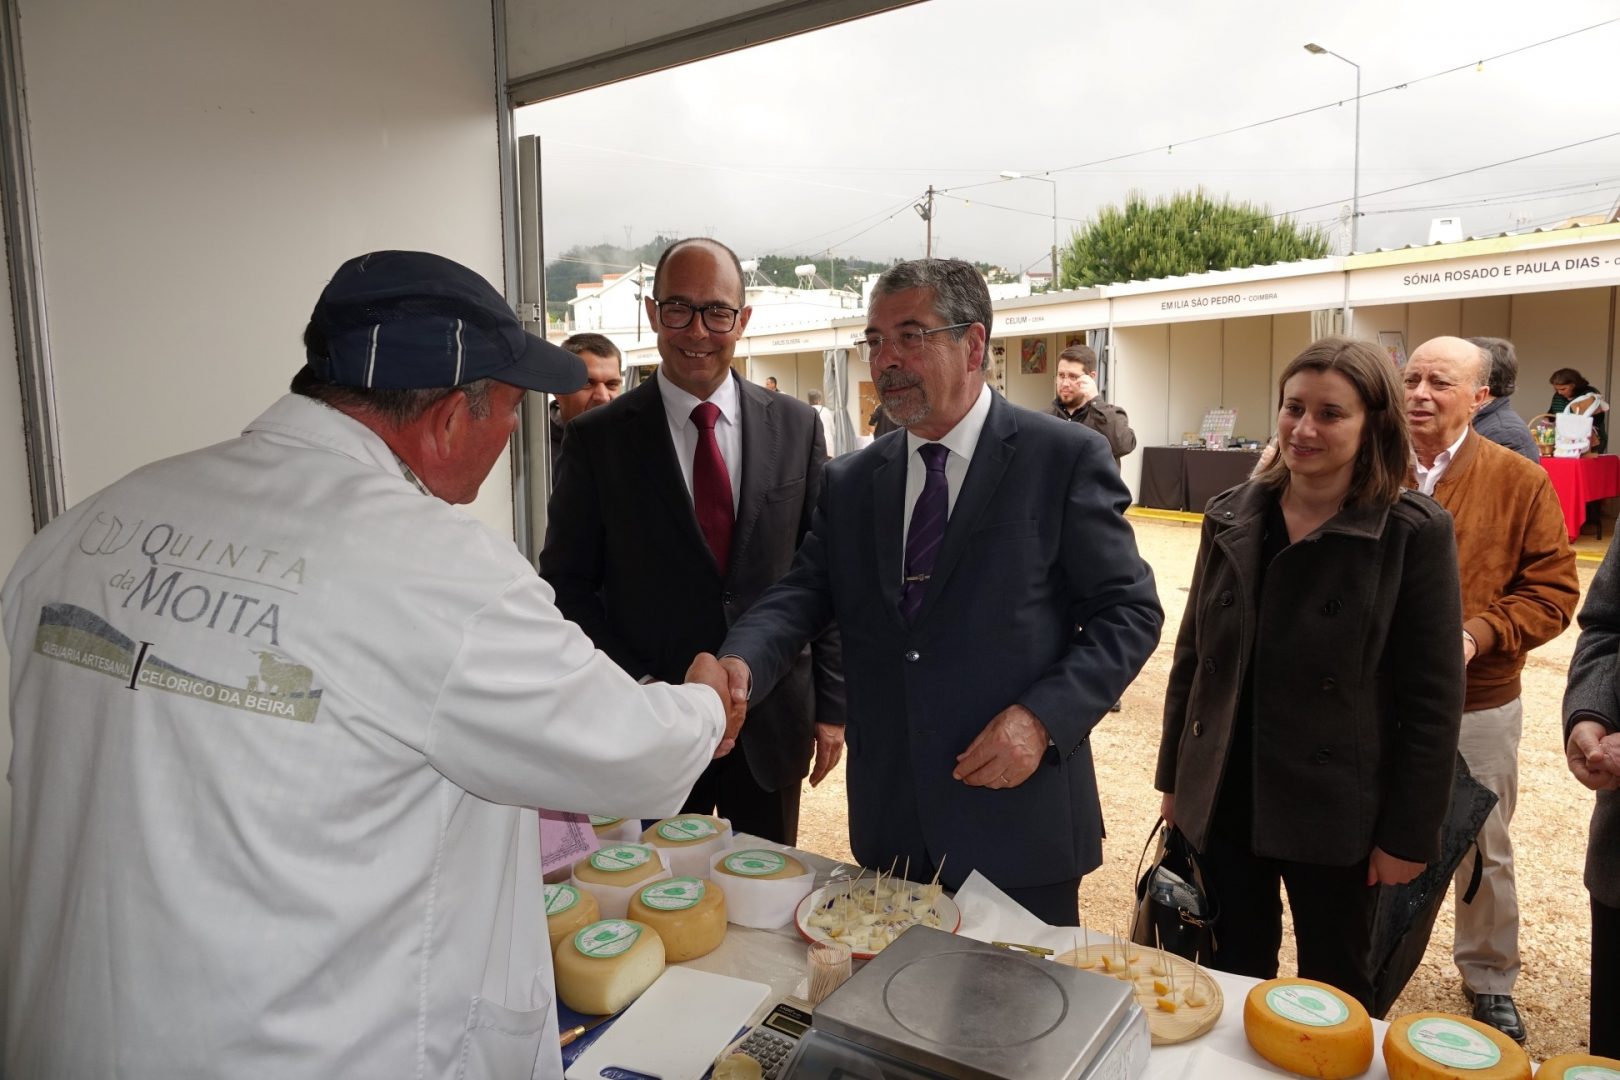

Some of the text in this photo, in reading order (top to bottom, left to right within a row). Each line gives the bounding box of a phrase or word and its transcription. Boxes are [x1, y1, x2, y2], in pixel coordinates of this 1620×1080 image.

[1211, 294, 1241, 306] PEDRO
[1248, 292, 1278, 302] COIMBRA
[1403, 272, 1441, 286] SÓNIA
[1444, 266, 1499, 282] ROSADO
[1503, 265, 1512, 276] E
[1516, 260, 1561, 275] PAULA
[1565, 256, 1600, 270] DIAS
[141, 523, 307, 585] QUINTA
[109, 566, 281, 647] da MOITA
[81, 652, 130, 678] ARTESANAL
[139, 669, 216, 699] CELORICO
[217, 689, 241, 705] DA
[244, 695, 296, 717] BEIRA
